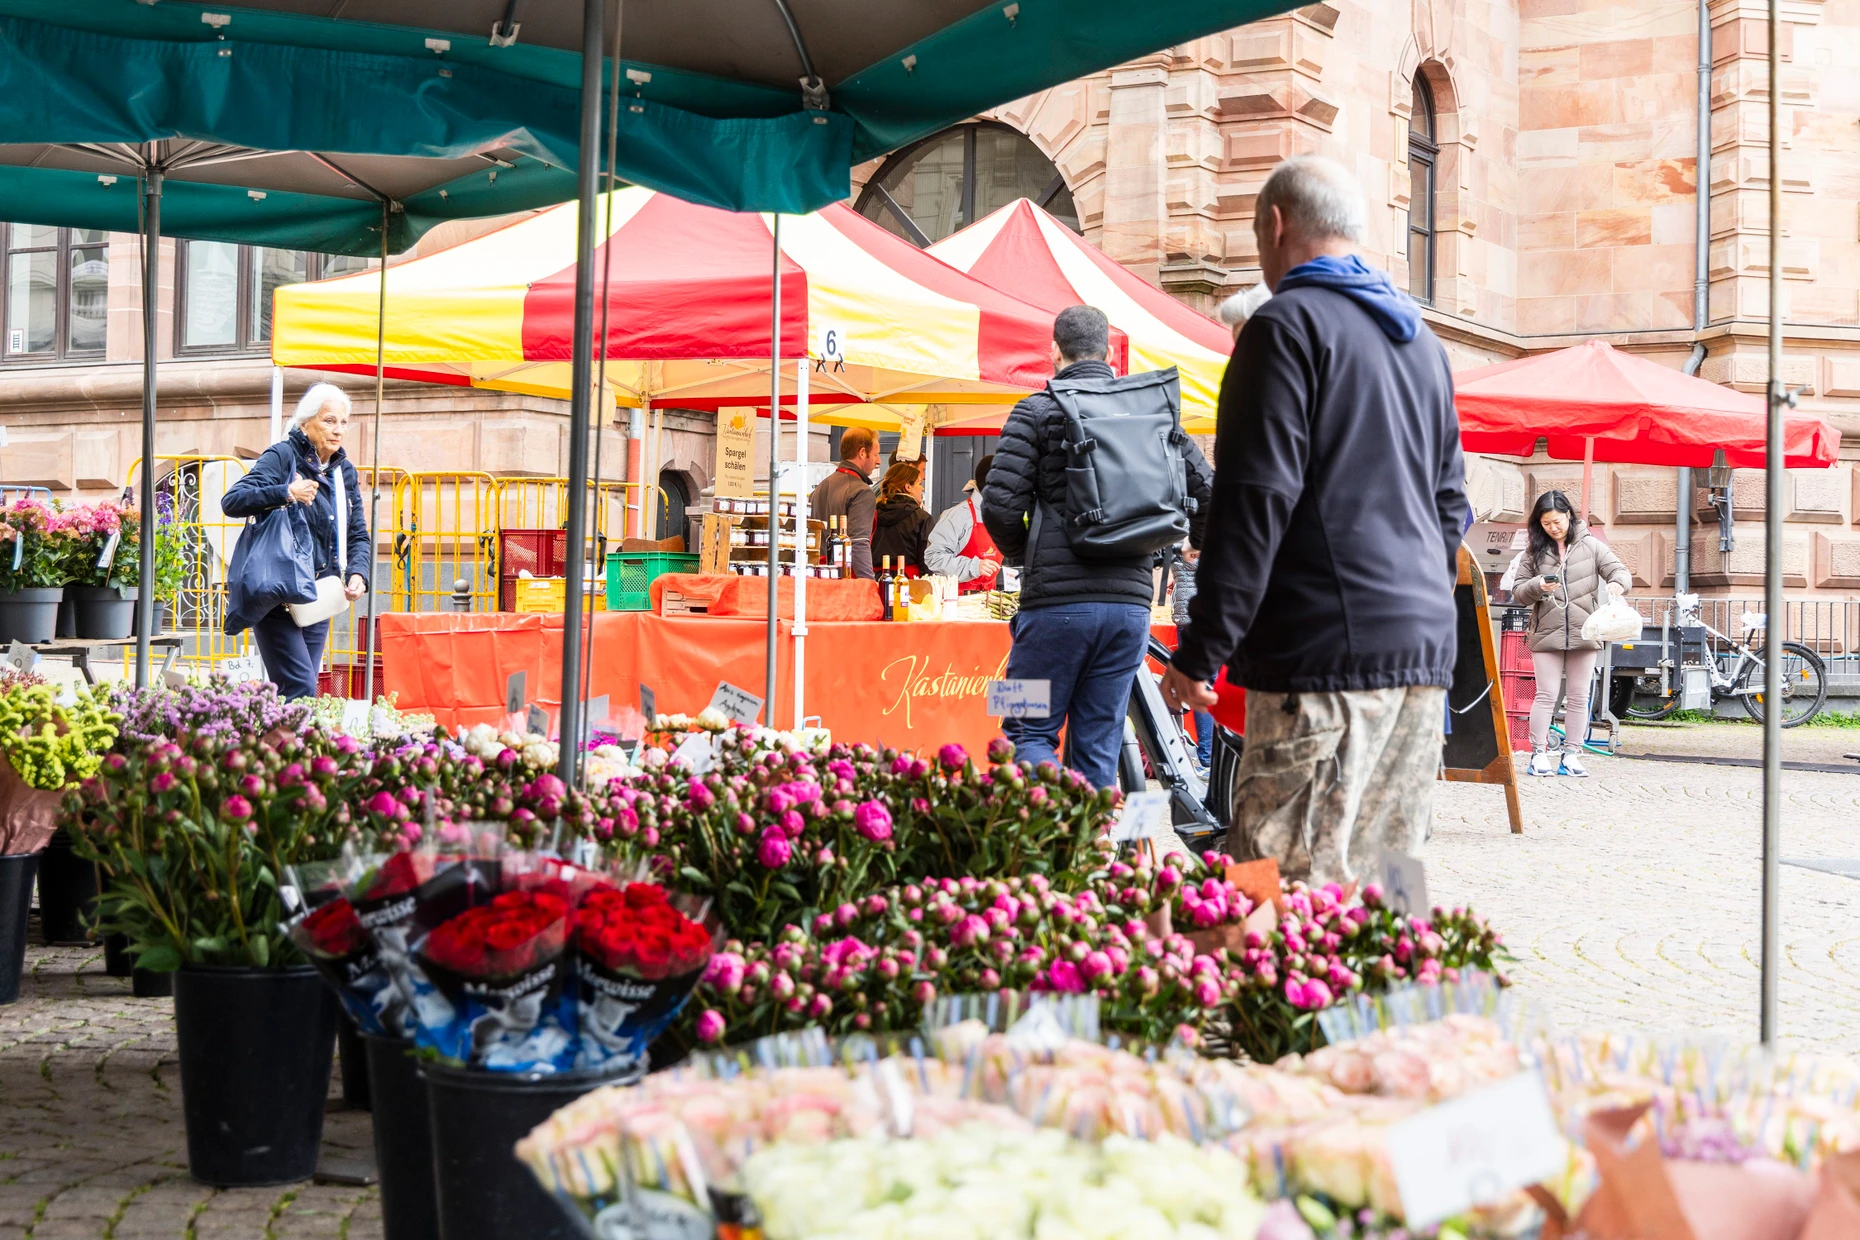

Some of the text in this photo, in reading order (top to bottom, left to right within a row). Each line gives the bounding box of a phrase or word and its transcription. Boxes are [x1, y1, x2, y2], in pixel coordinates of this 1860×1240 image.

[826, 330, 836, 356] 6
[725, 447, 747, 460] Spargel
[724, 461, 746, 471] schälen
